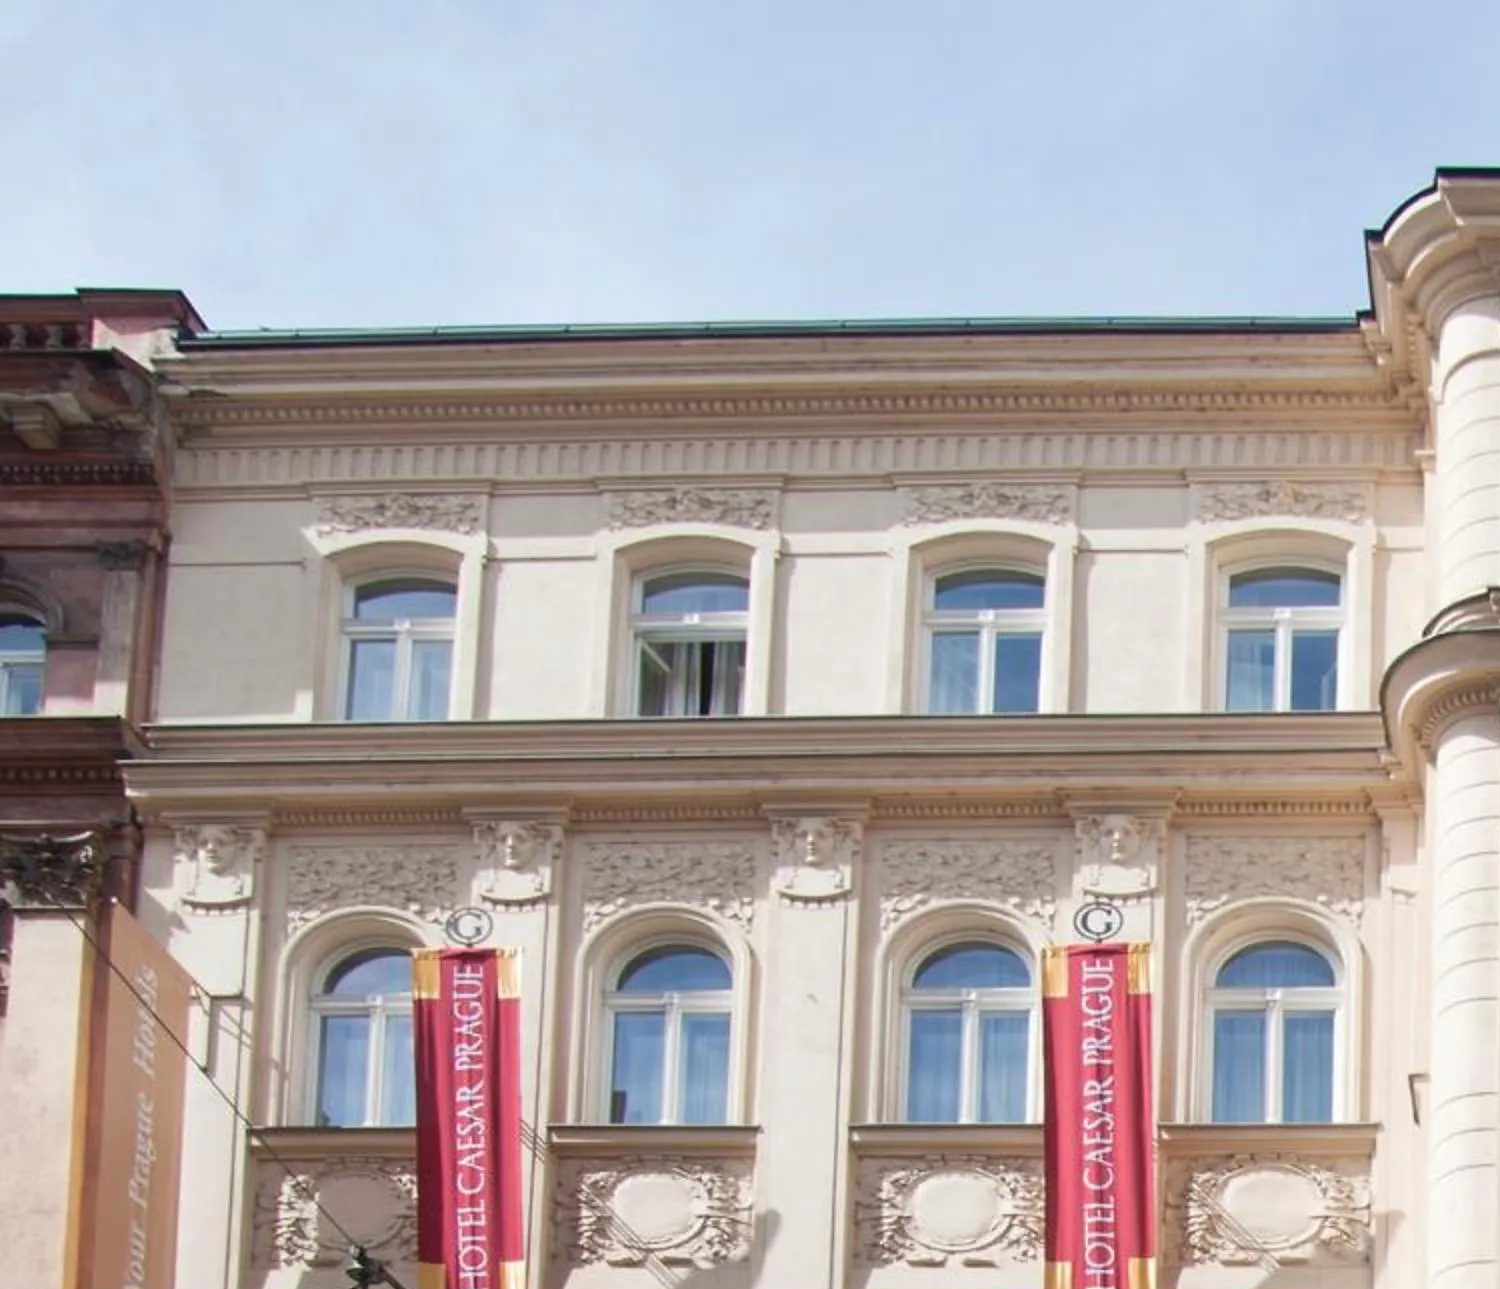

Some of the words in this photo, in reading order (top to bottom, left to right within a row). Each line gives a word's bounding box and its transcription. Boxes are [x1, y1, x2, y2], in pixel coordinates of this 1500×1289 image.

[132, 964, 160, 1080] Hotels
[453, 962, 485, 1073] PRAGUE
[1082, 958, 1115, 1069] PRAGUE
[127, 1093, 158, 1209] Prague
[455, 1081, 486, 1196] CAESAR
[1083, 1078, 1115, 1189] CAESAR
